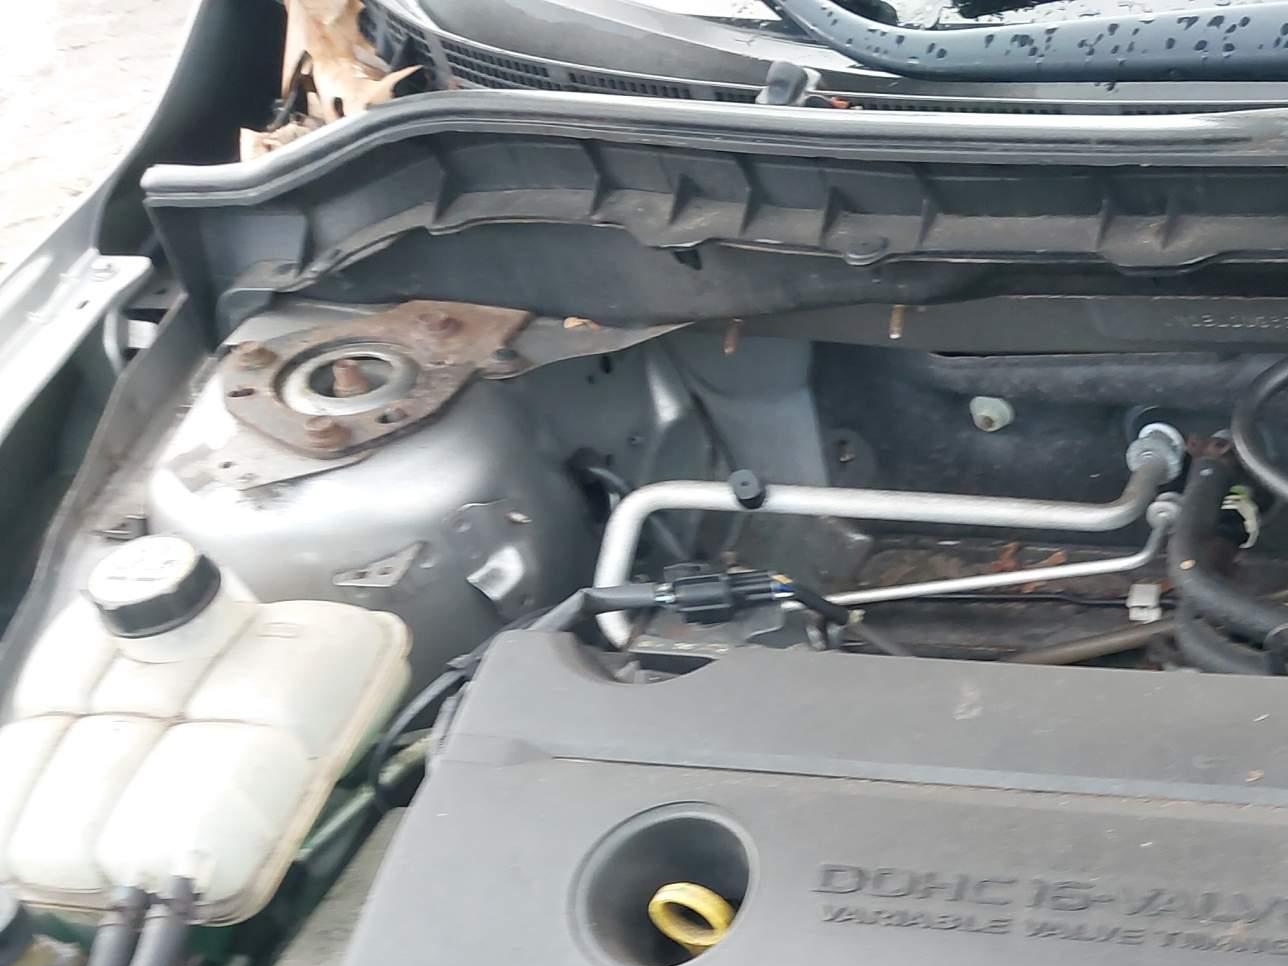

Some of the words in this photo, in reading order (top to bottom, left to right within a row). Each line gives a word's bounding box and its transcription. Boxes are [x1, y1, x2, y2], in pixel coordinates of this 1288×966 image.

[808, 862, 1018, 906] DOHC
[820, 903, 1014, 935] VARIABLE
[1023, 918, 1146, 946] VALVE
